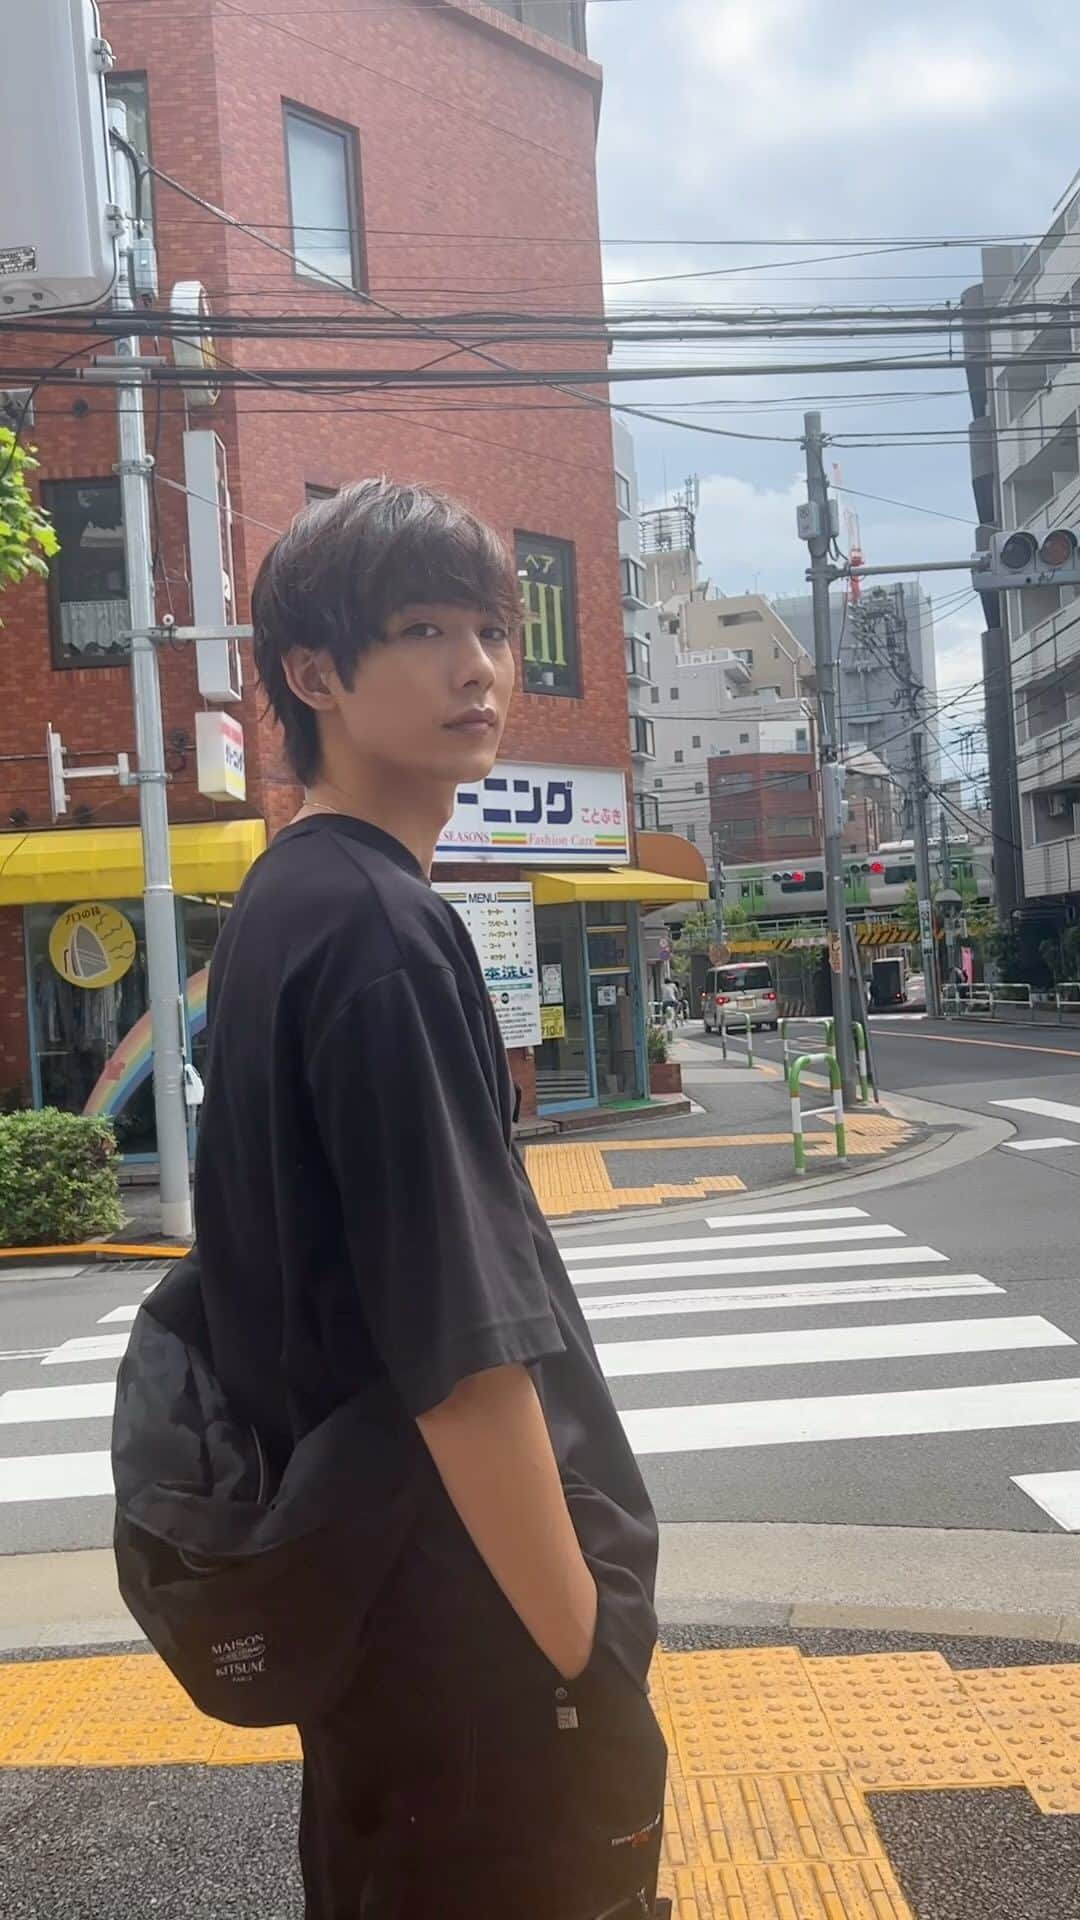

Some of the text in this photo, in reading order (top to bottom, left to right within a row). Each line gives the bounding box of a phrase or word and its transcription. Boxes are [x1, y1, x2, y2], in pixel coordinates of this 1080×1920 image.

[525, 554, 555, 573] ヘア
[581, 807, 622, 824] ことぶき
[443, 831, 490, 843] SEASONS
[529, 832, 594, 846] Fashion Care
[468, 893, 498, 904] MENU
[211, 1633, 264, 1654] MAISON
